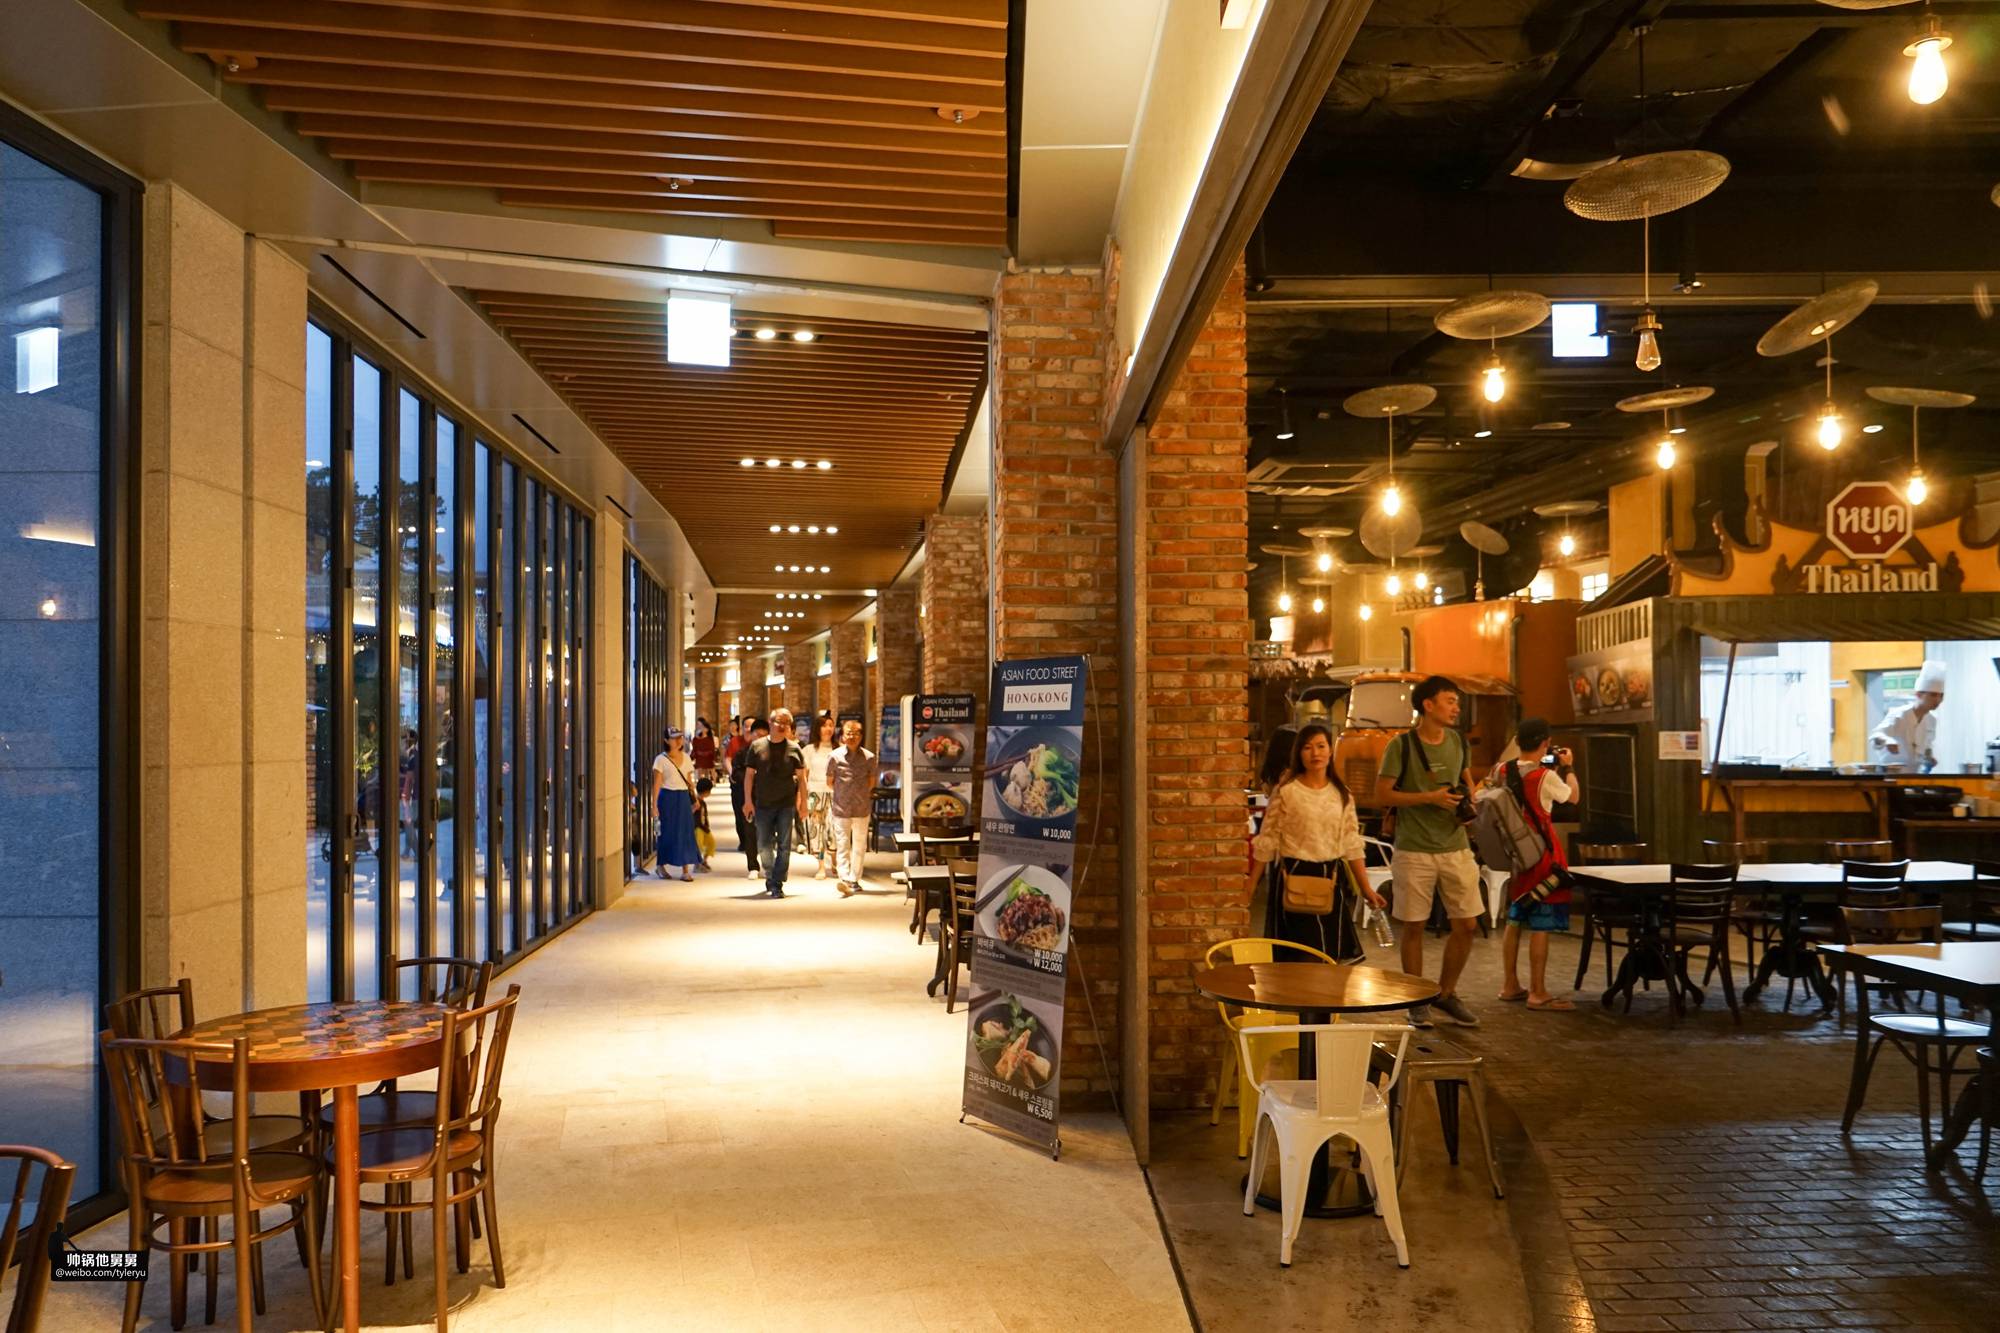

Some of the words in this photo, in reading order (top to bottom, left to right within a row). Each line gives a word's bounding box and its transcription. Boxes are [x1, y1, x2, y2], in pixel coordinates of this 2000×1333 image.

[1837, 505, 1905, 545] หยุด
[1802, 563, 1939, 594] Thailand
[1001, 669, 1024, 681] ASIAN
[1026, 668, 1050, 680] FOOD
[1052, 666, 1079, 679] STREET
[1007, 692, 1069, 704] HONGKONG
[934, 707, 969, 718] Thailand
[1050, 828, 1071, 840] 10,000
[1041, 950, 1063, 962] 10,000
[1041, 960, 1062, 973] 12,000
[1034, 1105, 1053, 1120] 6,500
